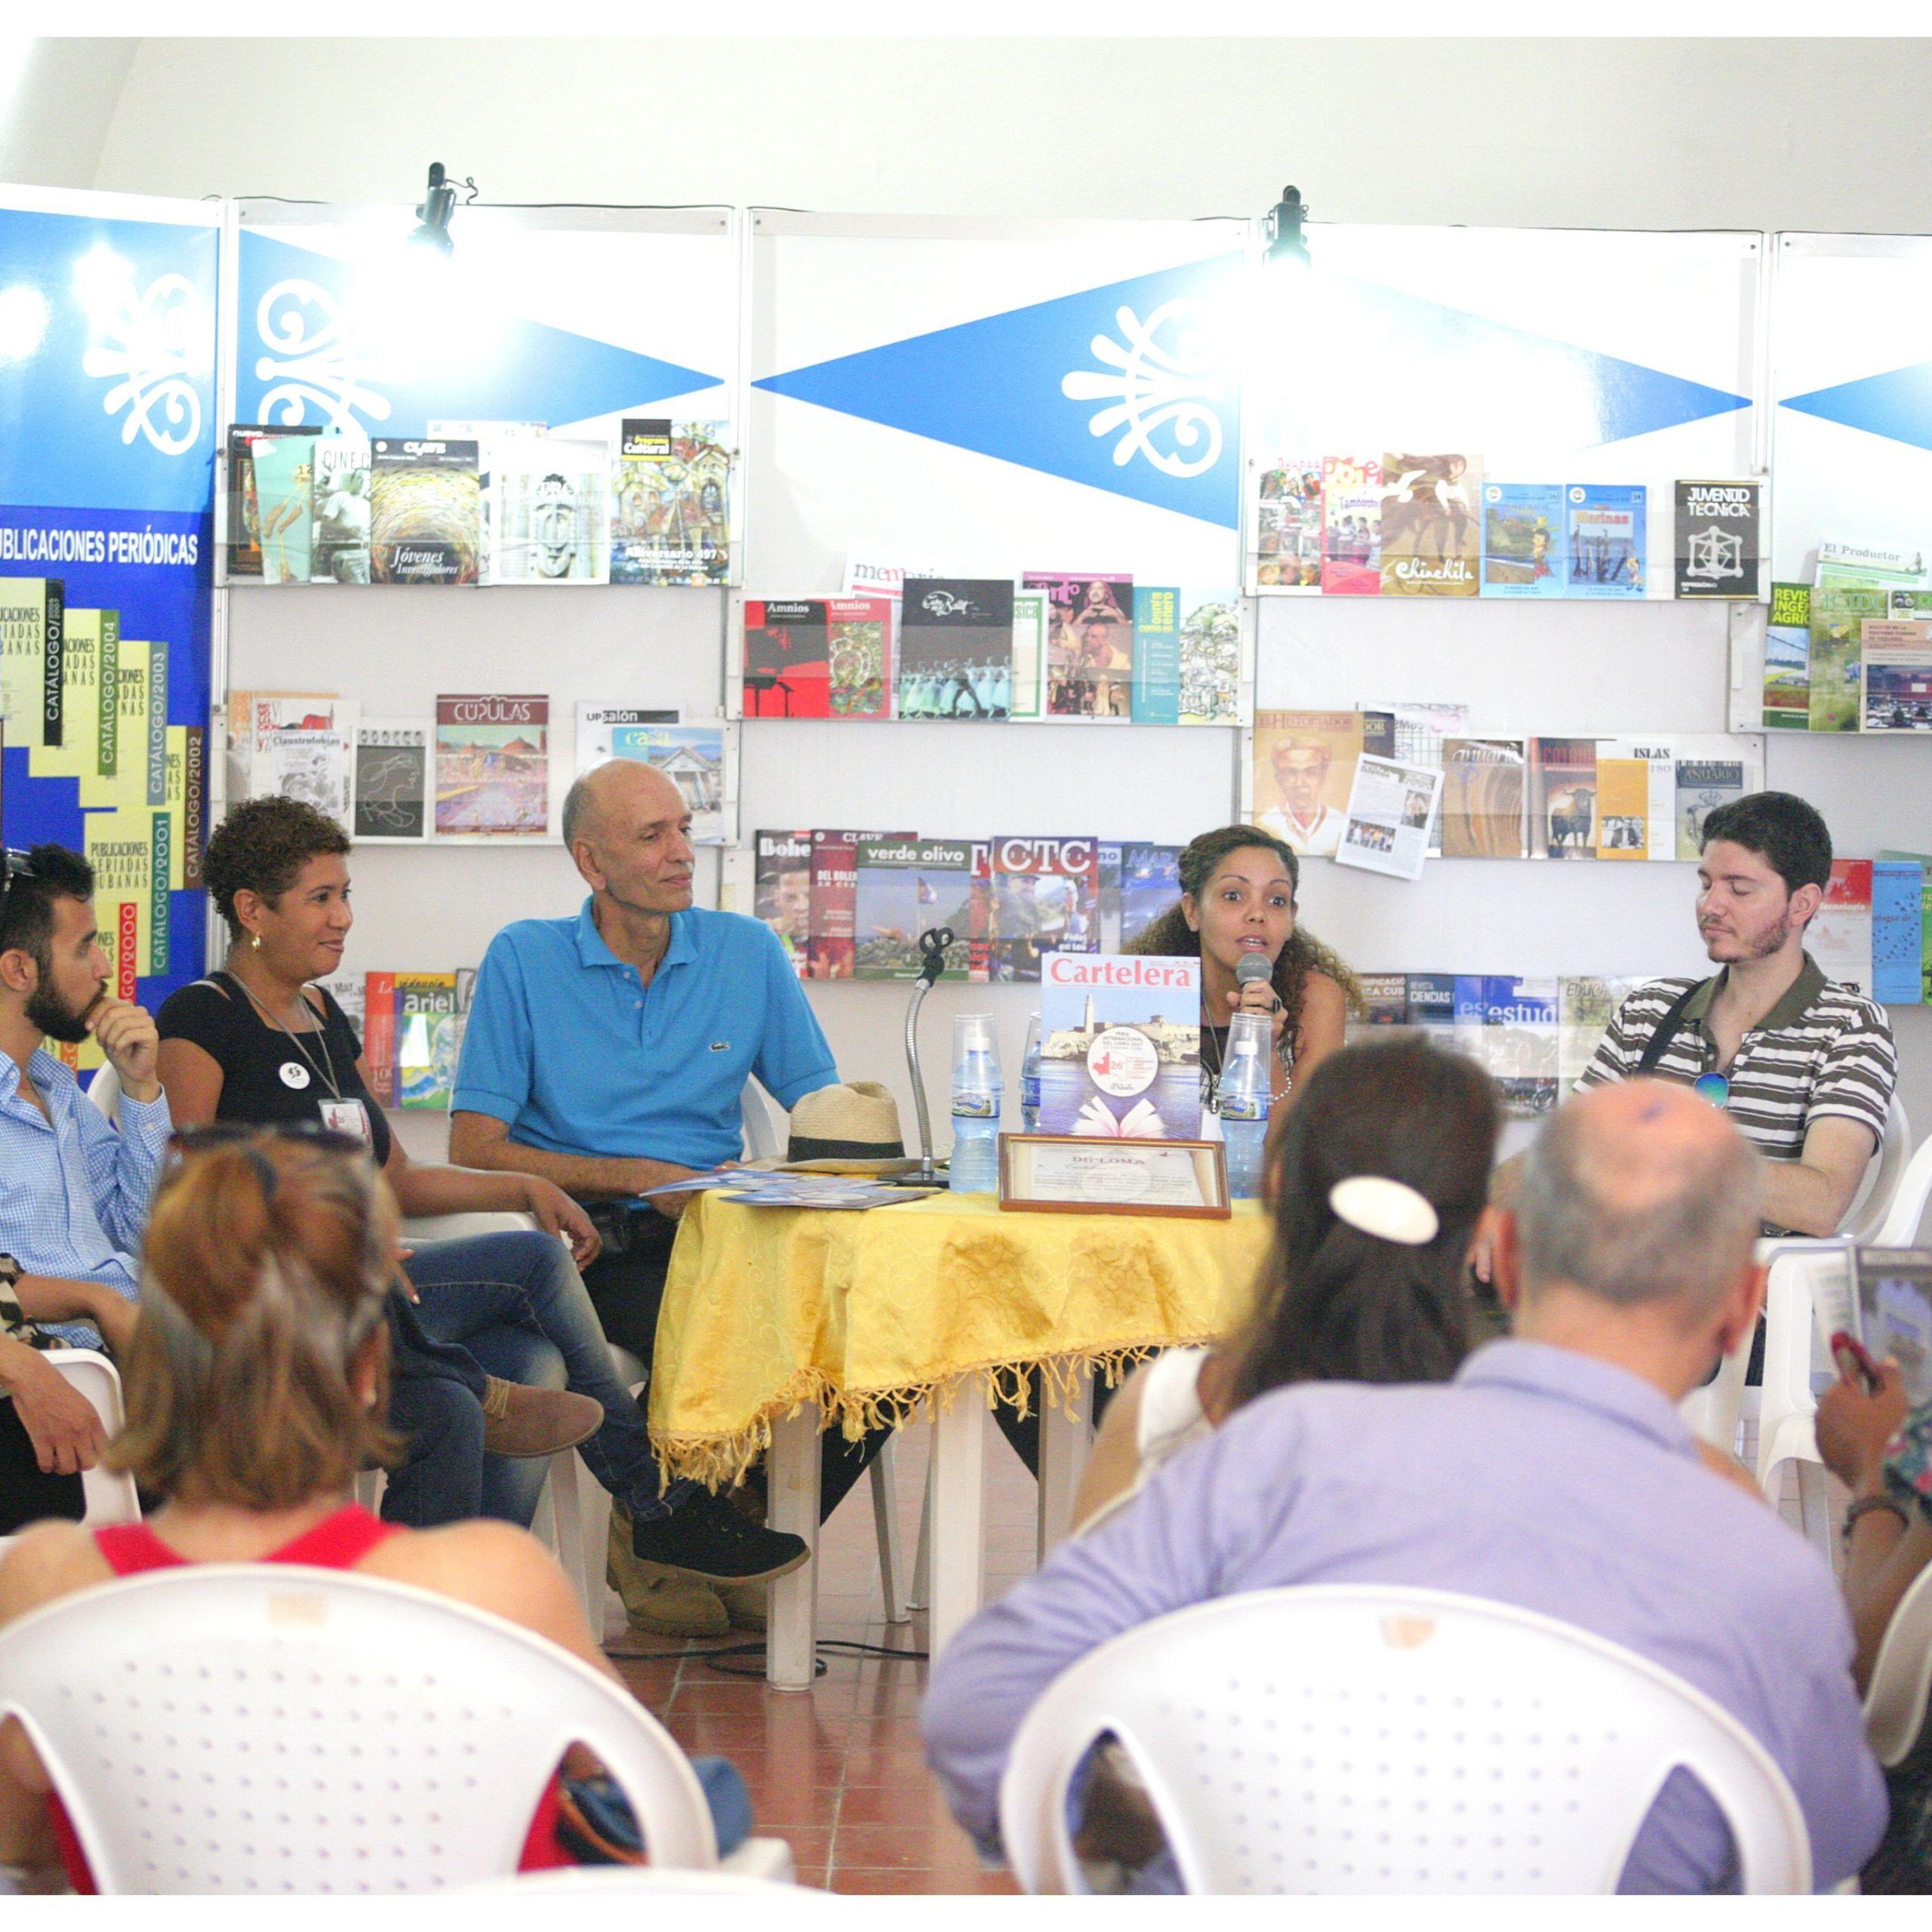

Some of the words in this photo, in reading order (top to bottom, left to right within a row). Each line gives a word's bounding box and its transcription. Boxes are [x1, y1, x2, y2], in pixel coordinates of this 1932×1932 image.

[623, 442, 670, 454] Cultural
[1687, 487, 1750, 503] JUVENTUD
[108, 525, 198, 565] PERIÓDICAS
[1823, 543, 1836, 553] El
[1841, 546, 1901, 561] Productor
[390, 546, 445, 568] Jóvenes
[768, 602, 810, 613] Amnios
[103, 621, 115, 764] CATÁLOGO/2004
[454, 702, 531, 722] CÚPULAS
[151, 651, 165, 794] CATÁLOGO/2003
[1633, 747, 1671, 759] ISLAS
[187, 737, 202, 878] CATÁLOGO/2002
[91, 842, 148, 857] PUBLICACIONES
[760, 838, 811, 857] Bohe
[867, 844, 917, 860] verde
[922, 845, 965, 861] olivo
[1001, 838, 1091, 874] CTC
[94, 874, 148, 889] UBANAS
[154, 820, 169, 969] CATÁLOGO/2001
[1051, 958, 1191, 987] Cartelera
[405, 992, 455, 1013] ariel
[1410, 992, 1451, 1004] CIENCIAS
[1110, 1061, 1123, 1070] 26
